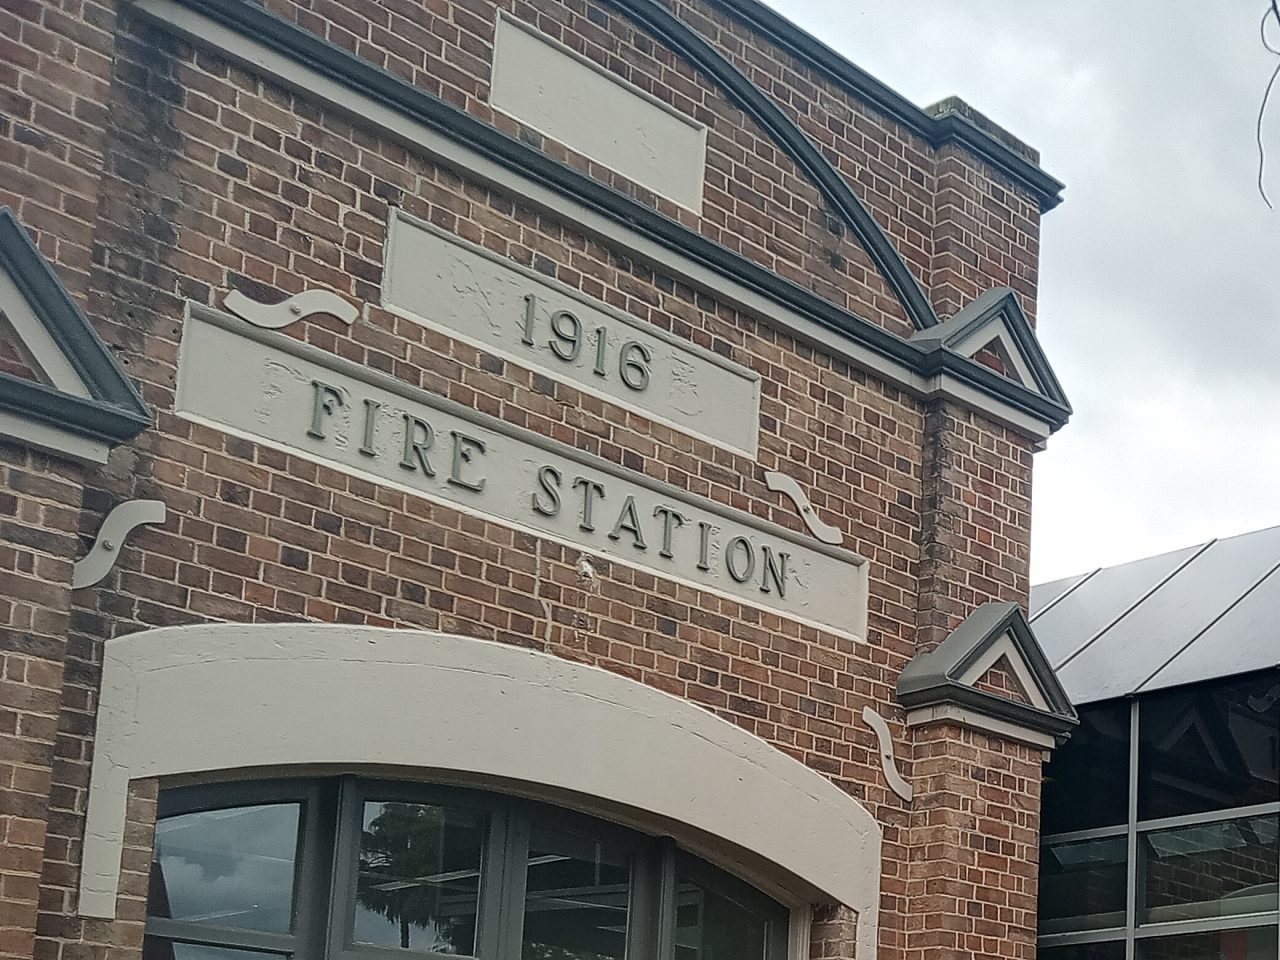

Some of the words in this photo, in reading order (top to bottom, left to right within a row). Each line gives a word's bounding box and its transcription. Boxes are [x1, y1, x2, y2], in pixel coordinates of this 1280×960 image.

[522, 293, 652, 392] 1916
[307, 379, 487, 492] FIRE
[532, 465, 791, 598] STATION
